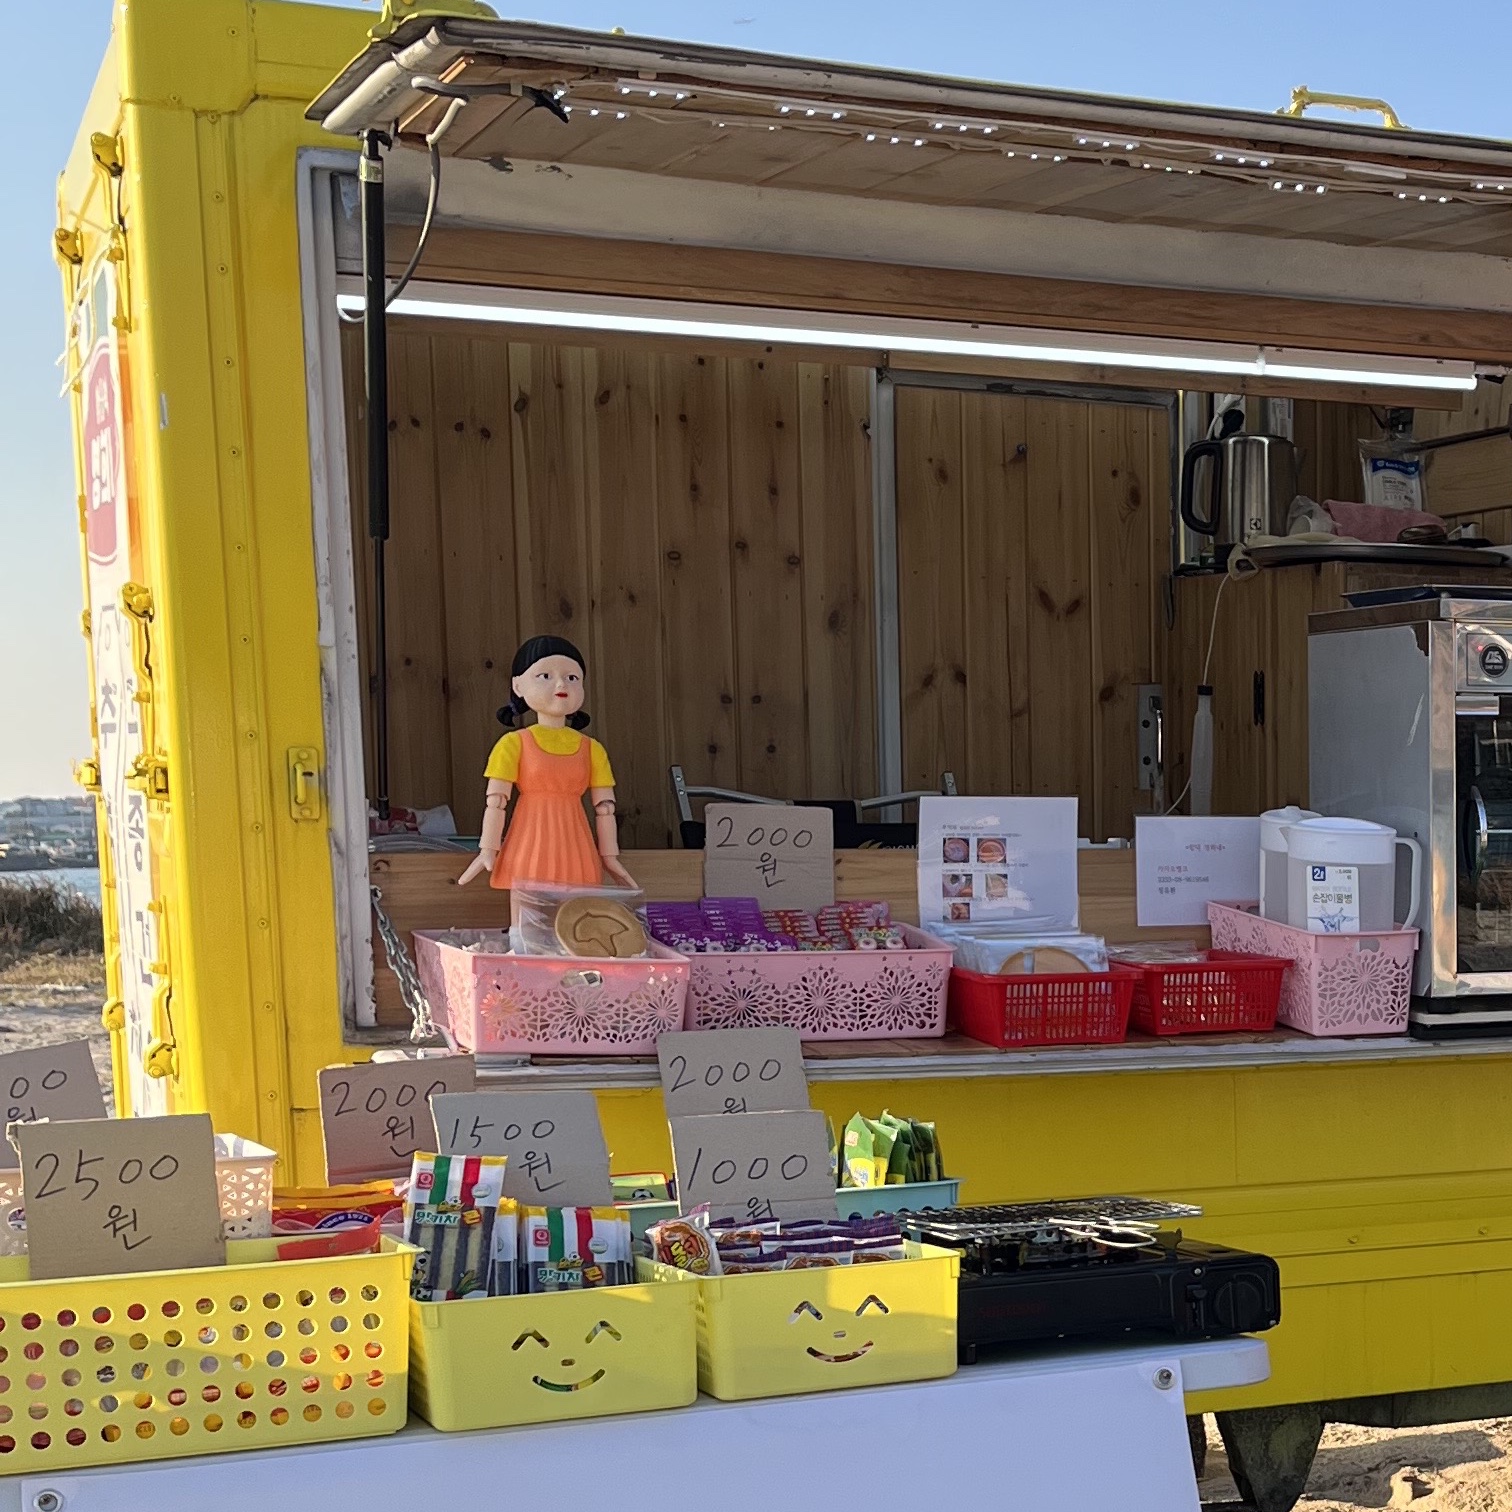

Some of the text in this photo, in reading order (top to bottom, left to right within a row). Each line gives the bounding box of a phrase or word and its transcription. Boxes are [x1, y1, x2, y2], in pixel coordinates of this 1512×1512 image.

[715, 816, 813, 849] 2000
[755, 851, 787, 889] 원
[1312, 892, 1353, 905] 손잡이물병
[9, 1069, 68, 1099] 00
[668, 1054, 782, 1093] 2000
[331, 1080, 447, 1117] 2000
[381, 1114, 421, 1158] 원
[450, 1115, 556, 1149] 1500
[34, 1148, 180, 1201] 2500
[518, 1150, 568, 1193] 원
[687, 1146, 809, 1192] 1000
[102, 1204, 153, 1251] 원
